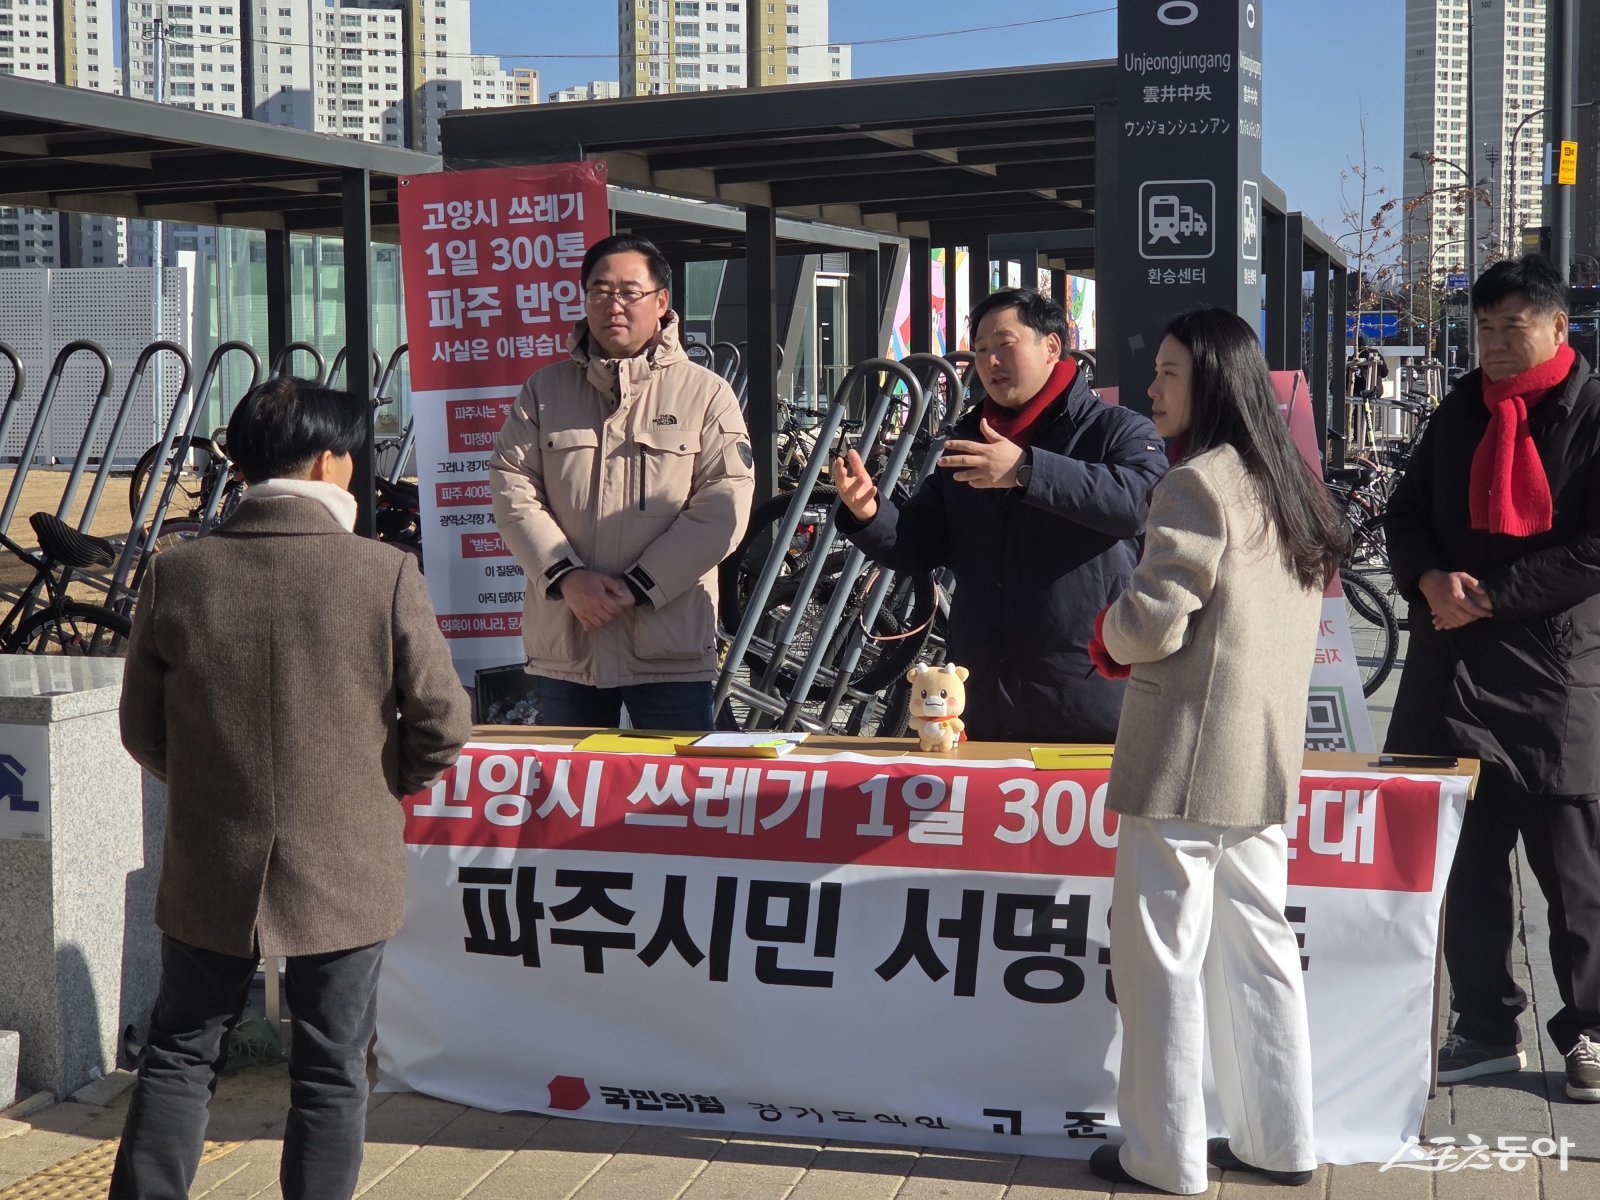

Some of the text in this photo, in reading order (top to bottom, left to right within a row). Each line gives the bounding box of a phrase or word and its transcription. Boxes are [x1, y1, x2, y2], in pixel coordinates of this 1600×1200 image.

[1124, 51, 1231, 76] Unjeongjungang
[1143, 83, 1212, 103] 雲井中央
[422, 191, 584, 231] 고양시 쓰레기
[424, 231, 587, 277] 1일 300톤
[1147, 267, 1206, 285] 환승센터
[427, 279, 587, 329] 파주 반입
[432, 338, 490, 363] 사실은
[454, 405, 497, 420] 파주시는
[437, 460, 465, 473] 그러나
[441, 487, 463, 500] 파주
[440, 513, 485, 527] 광역소각장
[485, 566, 495, 577] 이
[478, 593, 497, 604] 아직
[441, 618, 471, 632] 의혹이
[413, 754, 604, 828] 고양시
[624, 763, 828, 839] 쓰레기
[856, 773, 969, 846] 1일
[457, 866, 843, 989] 파주시민
[599, 1085, 726, 1115] 국민의힘
